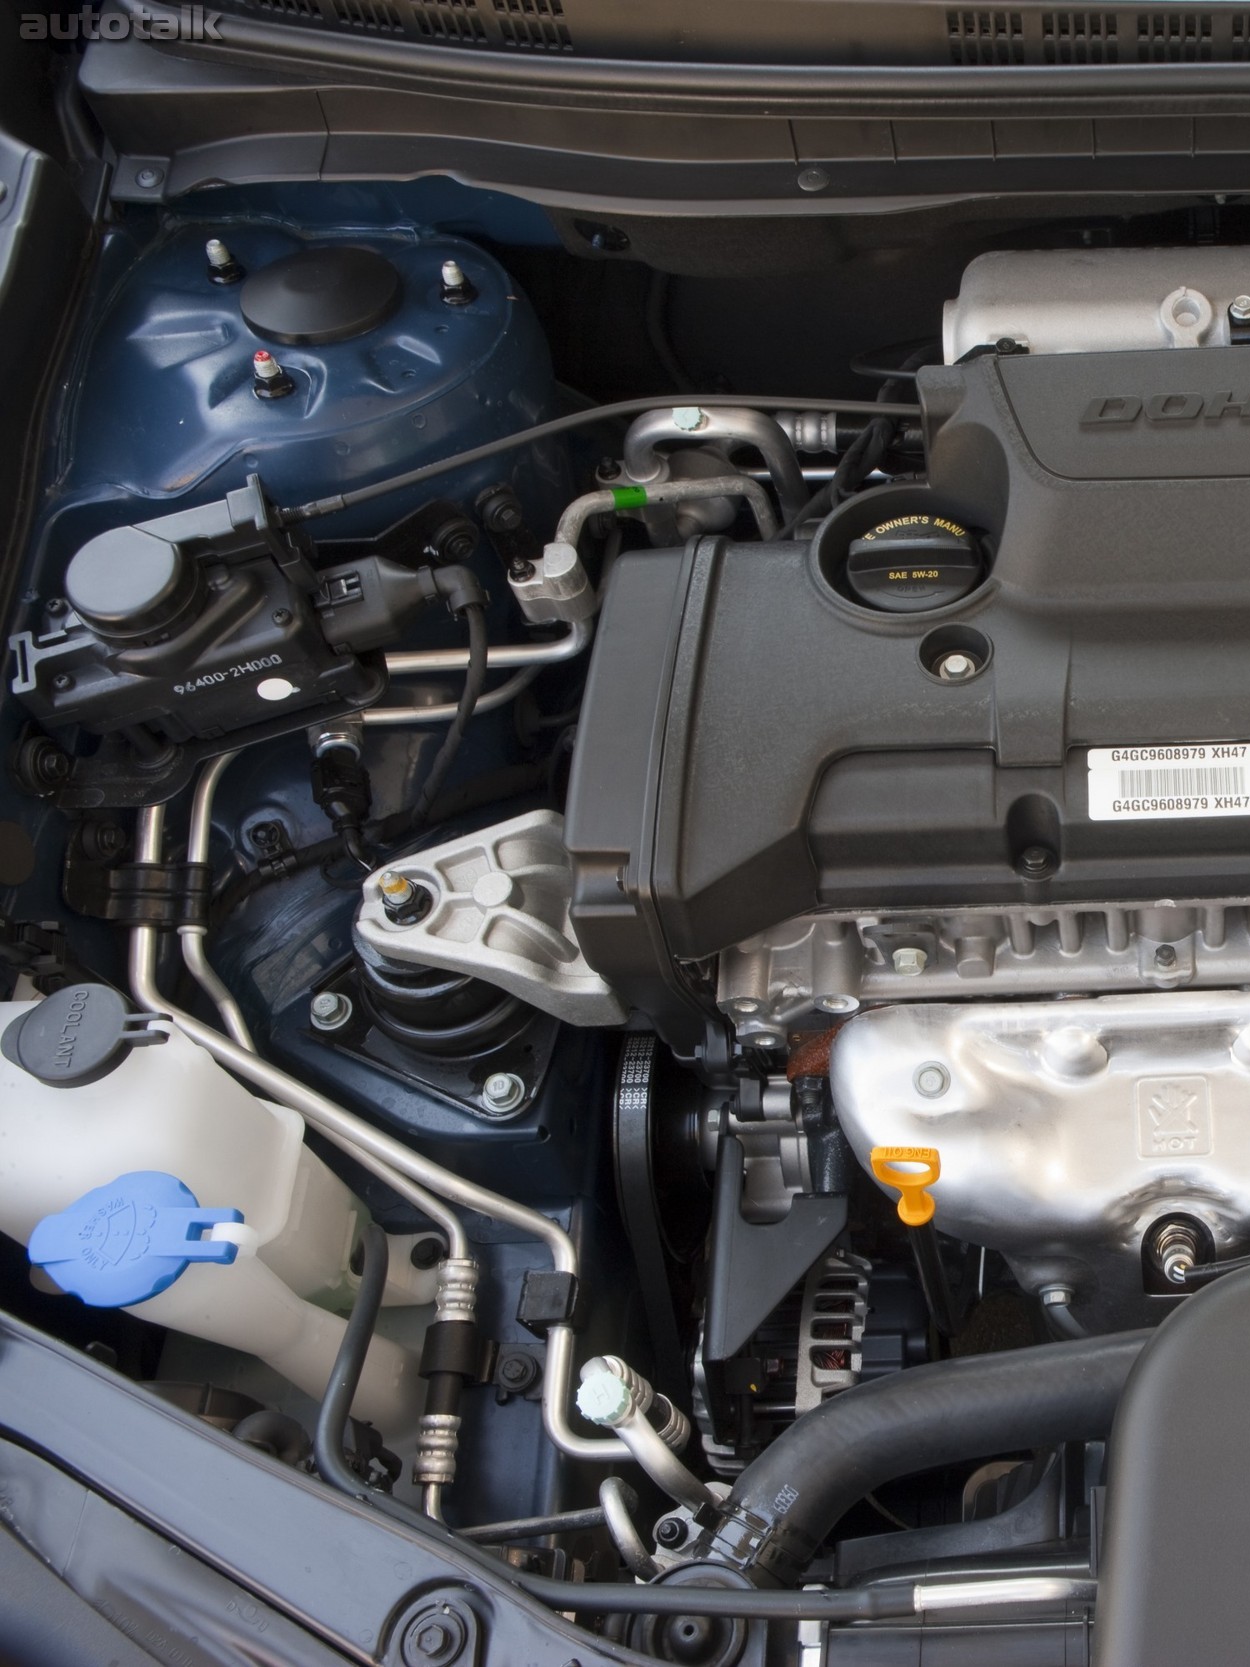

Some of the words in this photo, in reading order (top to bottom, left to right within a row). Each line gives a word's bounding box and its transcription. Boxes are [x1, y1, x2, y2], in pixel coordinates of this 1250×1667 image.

[875, 515, 930, 535] OWNER'S
[888, 571, 908, 580] SAE
[912, 570, 939, 579] 5W-20
[173, 653, 283, 696] 96400-2H000
[1111, 747, 1206, 762] G4GC9608979
[1211, 746, 1248, 759] XH47
[1112, 797, 1209, 813] G4GC9608979
[1214, 796, 1250, 809] XH47
[54, 989, 90, 1069] COOLANT
